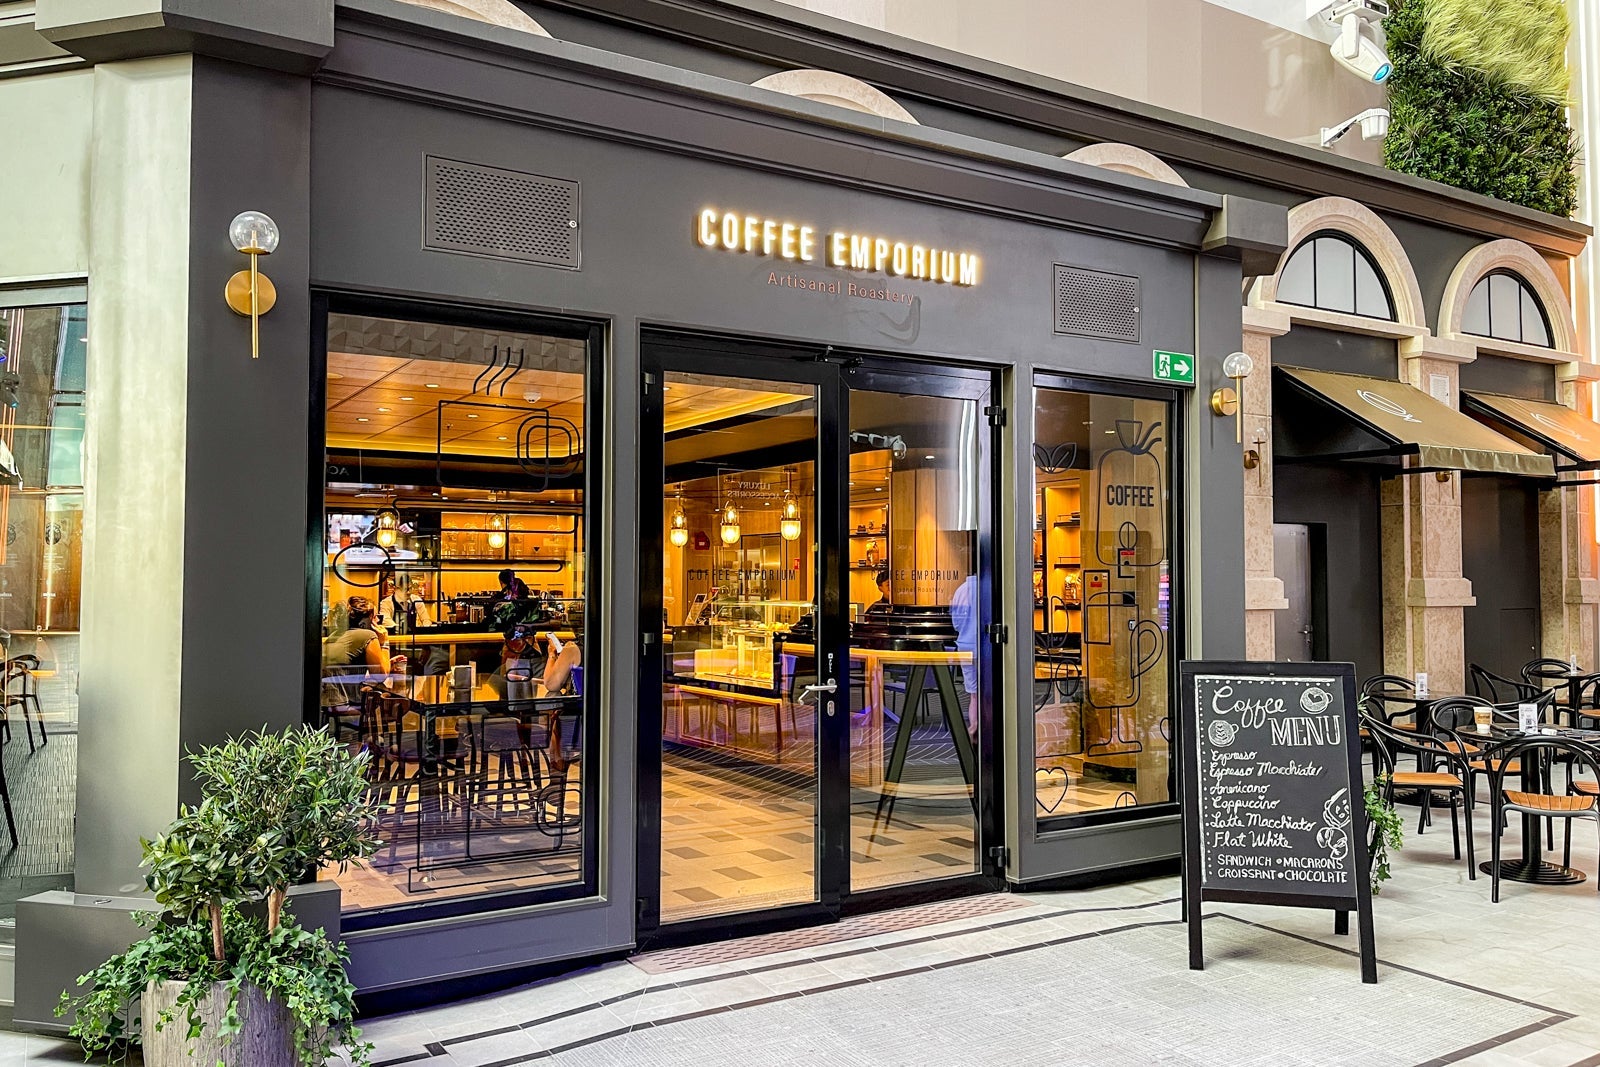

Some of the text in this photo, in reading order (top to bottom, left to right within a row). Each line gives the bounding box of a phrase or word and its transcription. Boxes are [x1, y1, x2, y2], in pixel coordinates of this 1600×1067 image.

[699, 208, 978, 286] COFFEE EMPORIUM
[767, 271, 914, 306] Artisanal Roastery
[1106, 484, 1155, 507] COFFEE
[688, 569, 796, 581] COFFEE EMPORIUM
[911, 569, 959, 581] EMPORIUM
[1211, 686, 1287, 729] Coffee
[1268, 715, 1341, 746] MENU
[1210, 749, 1257, 766] Espresso
[1209, 762, 1254, 781] Espresso
[1210, 780, 1270, 795] Americano
[1211, 795, 1280, 815] Cappuccino
[1210, 812, 1316, 832] Latte Macchiato
[1212, 831, 1293, 849] Flat White
[1217, 854, 1344, 870] SANDWICH MACARONS
[1218, 868, 1348, 883] CROISSANT CHOCOLATE
